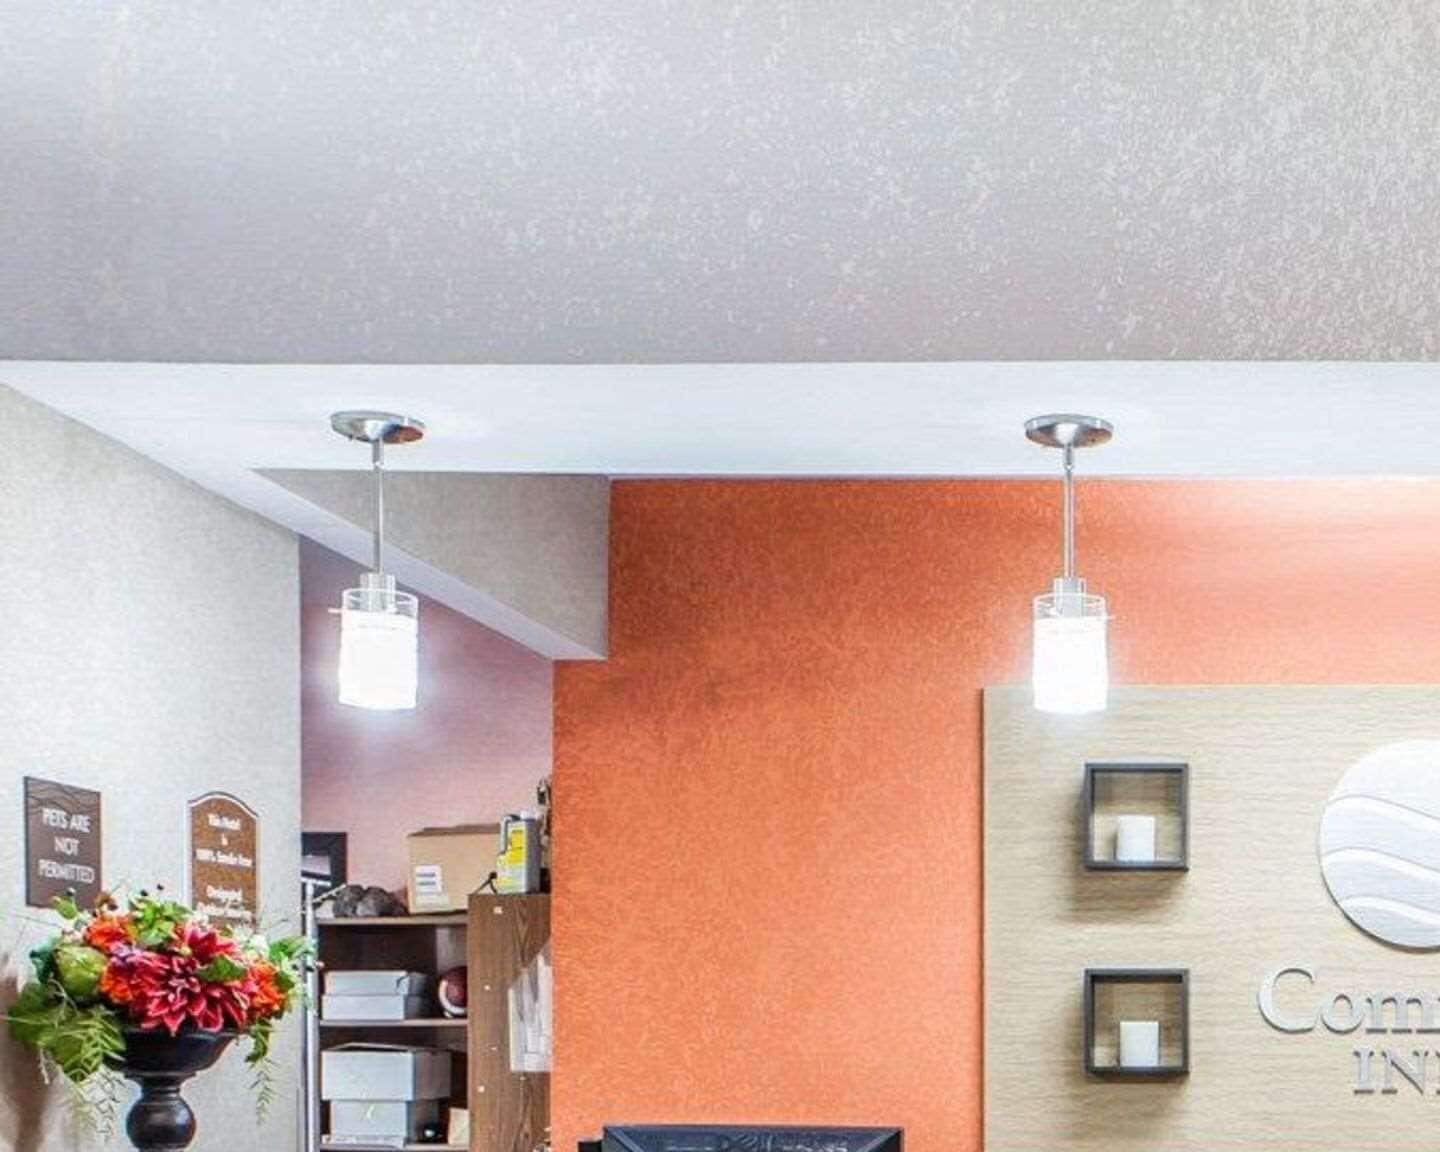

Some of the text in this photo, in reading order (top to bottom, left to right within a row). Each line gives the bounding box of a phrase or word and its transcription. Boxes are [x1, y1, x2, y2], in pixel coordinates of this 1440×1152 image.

[42, 807, 92, 833] PETS ARE
[54, 836, 80, 856] NOT
[38, 858, 96, 884] PERMITTED
